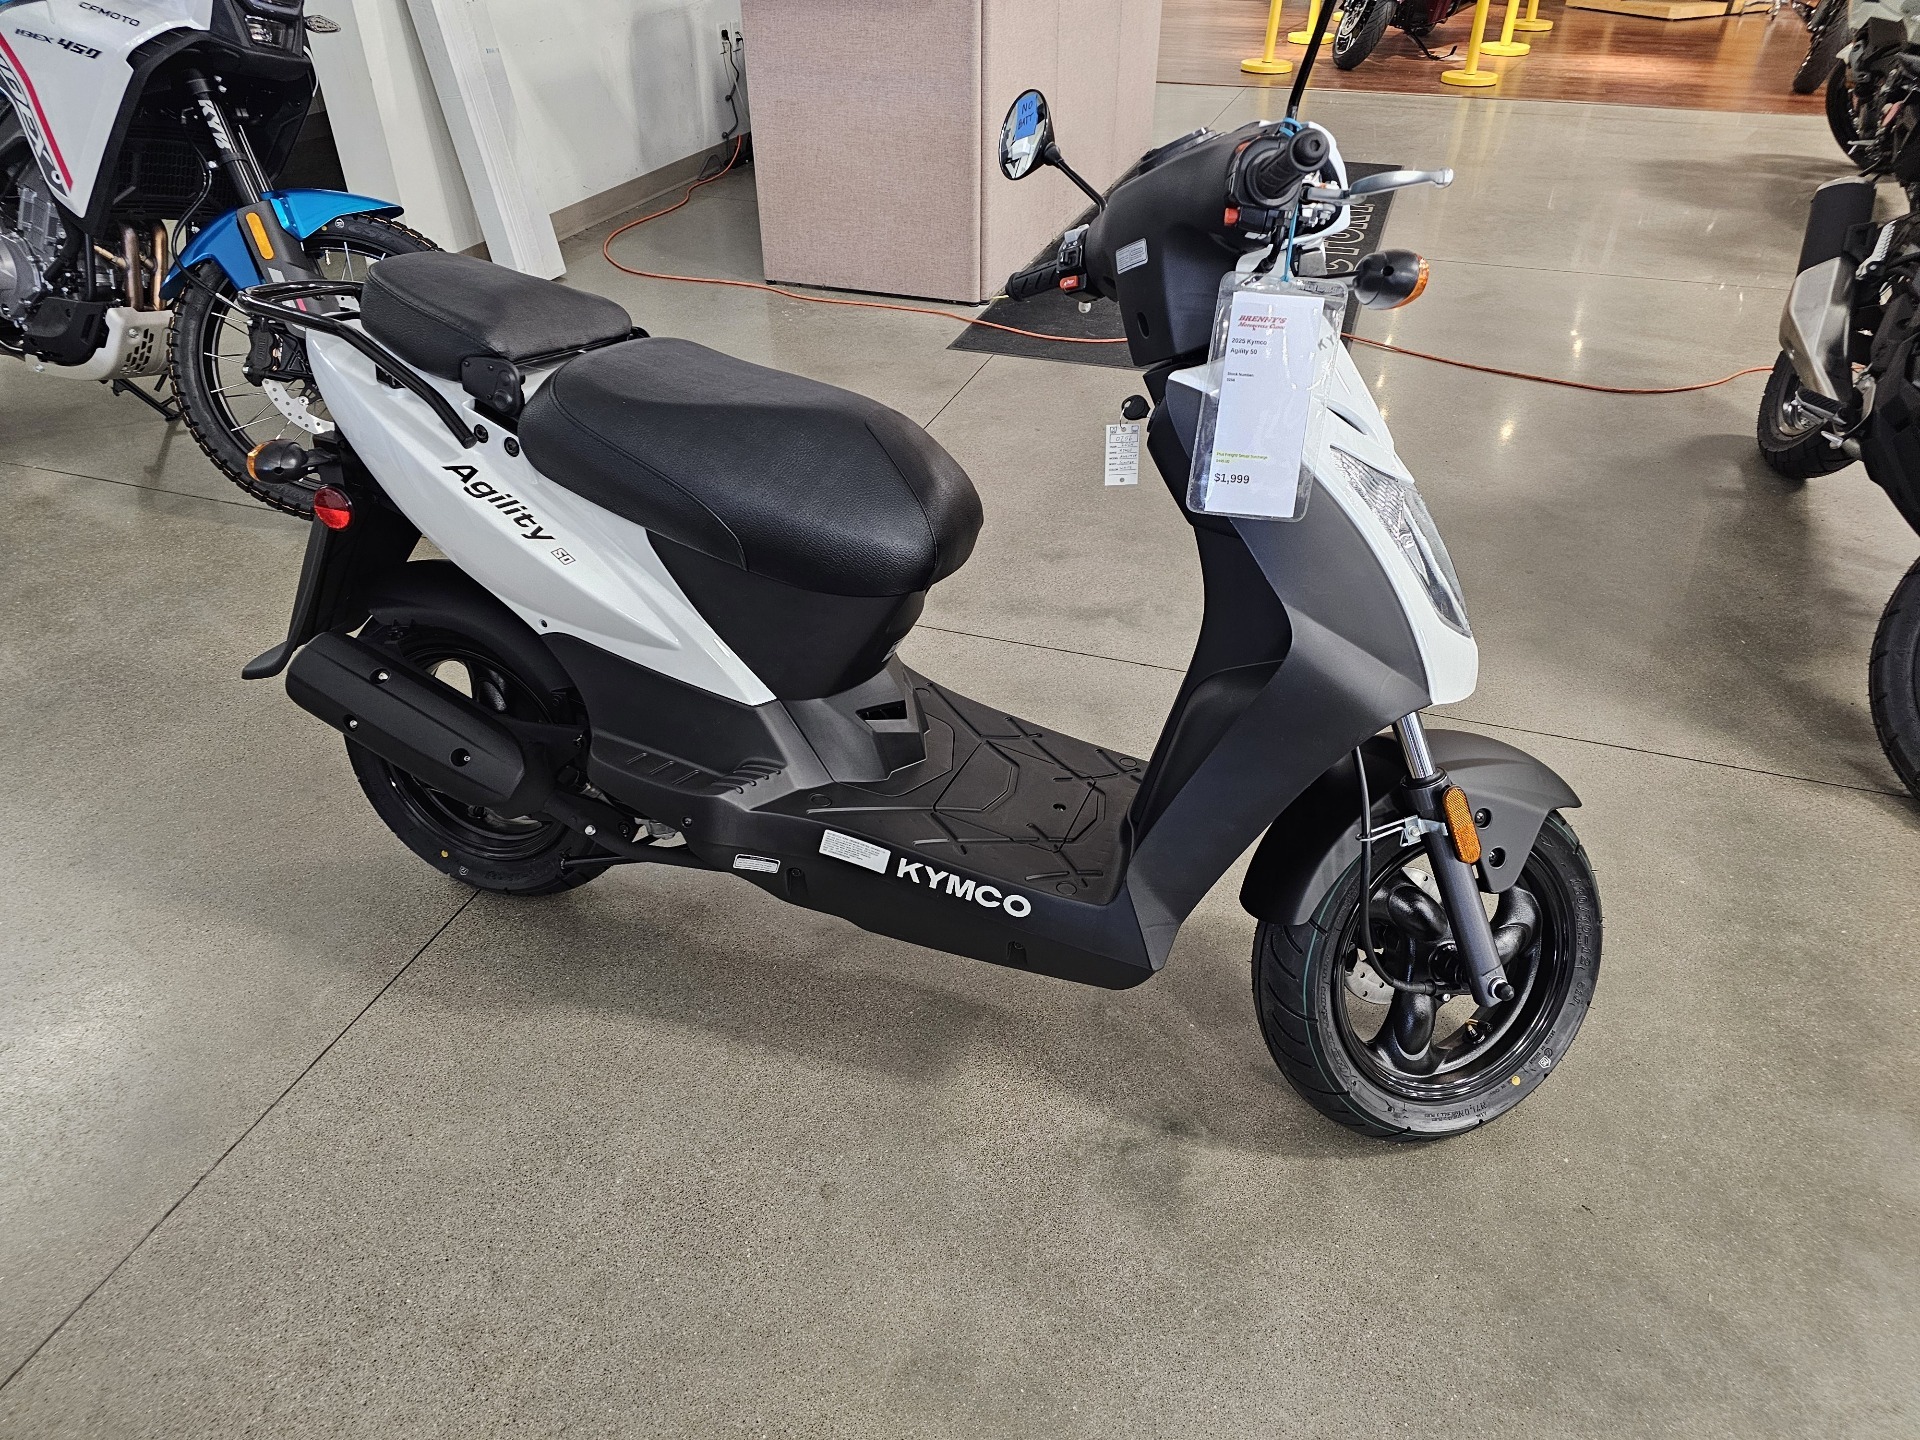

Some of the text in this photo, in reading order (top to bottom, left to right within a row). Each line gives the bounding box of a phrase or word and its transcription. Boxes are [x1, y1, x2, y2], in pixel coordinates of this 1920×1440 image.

[79, 1, 140, 27] CFMOTO
[57, 38, 103, 59] 450
[1021, 100, 1034, 115] NO
[1017, 112, 1035, 130] BATT
[1213, 472, 1250, 485] $1,999
[441, 465, 556, 540] Agility
[896, 857, 1032, 918] KYMCO
